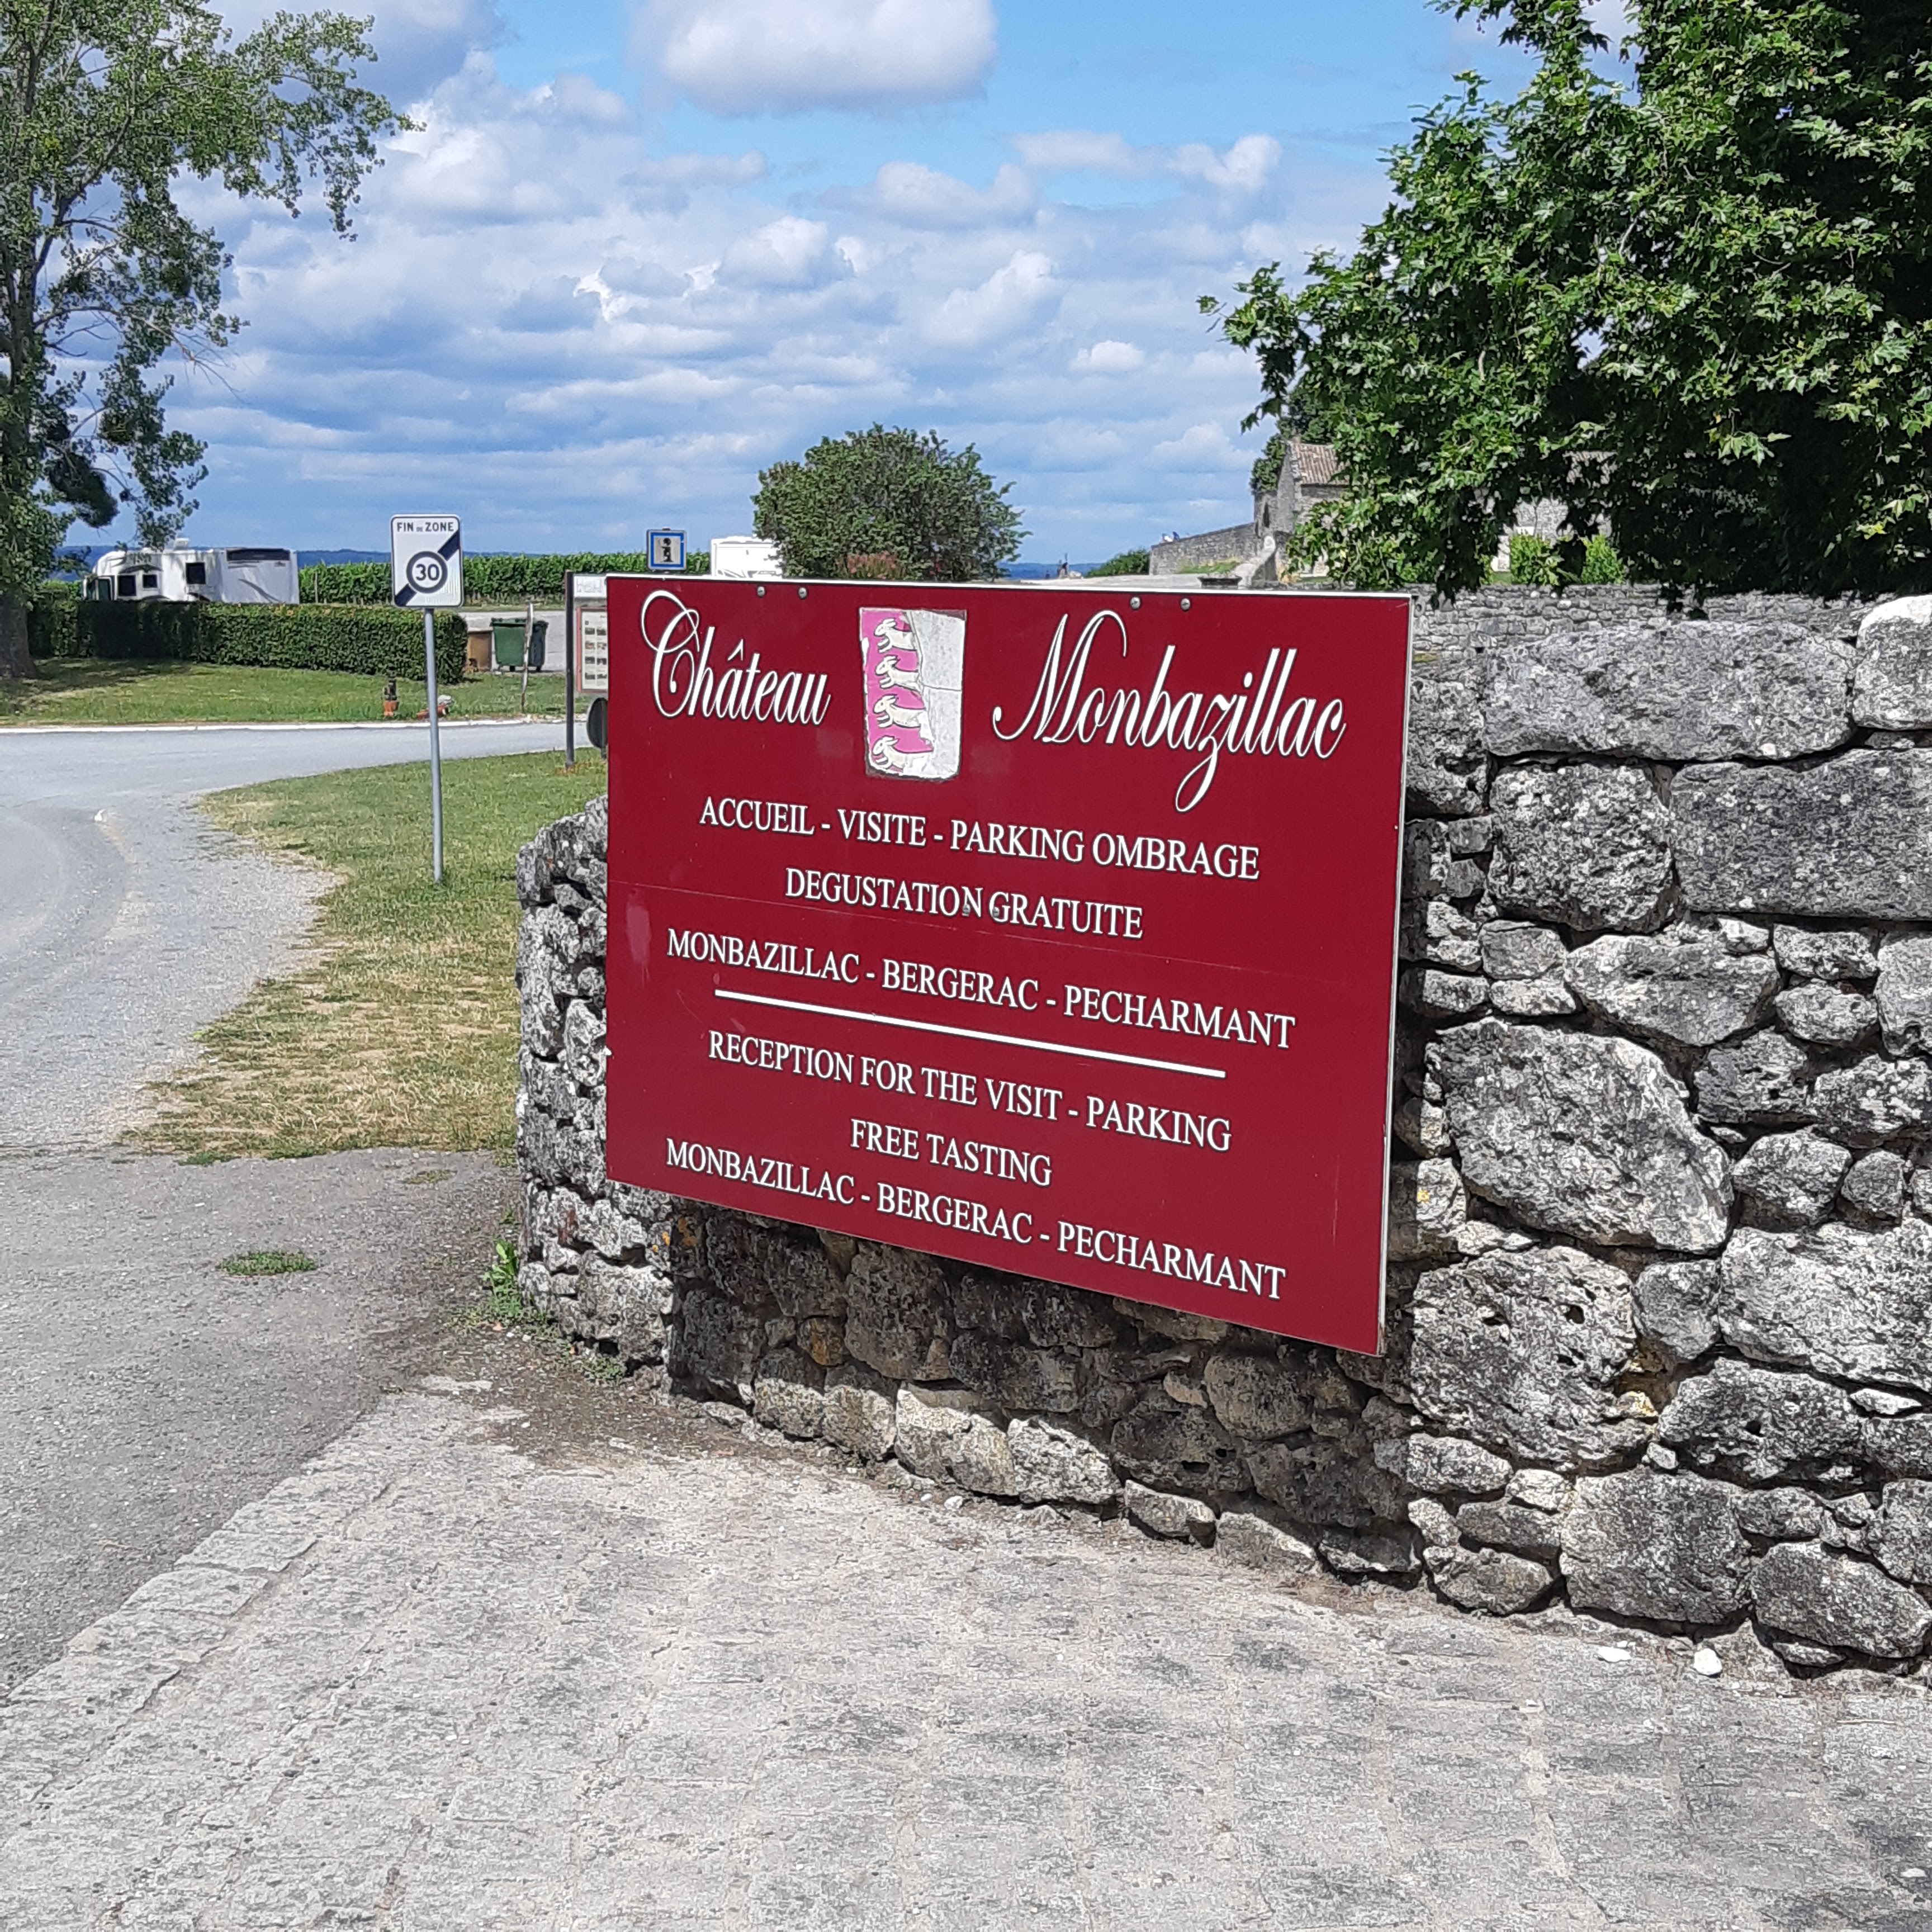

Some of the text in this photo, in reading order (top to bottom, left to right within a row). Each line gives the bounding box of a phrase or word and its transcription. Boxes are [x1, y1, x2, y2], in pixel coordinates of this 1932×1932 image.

[396, 522, 414, 532] FIN
[425, 522, 454, 532] ZONE
[415, 564, 440, 581] 30
[641, 590, 831, 725] Château
[992, 610, 1347, 812] Monbazillac
[699, 796, 815, 835] ACCUEIL
[837, 809, 927, 849] VISITE
[950, 820, 1085, 863] PARKING
[1092, 833, 1259, 879] OMBRAGE
[785, 868, 1143, 939] DEGUSTATION GRATUITE
[667, 928, 859, 984] MONBAZILLAC
[882, 959, 1038, 1011] BERGERAC
[1063, 984, 1295, 1048] PECHARMANT
[708, 1030, 854, 1083] RECEPTION
[860, 1056, 916, 1095] FOR
[921, 1067, 978, 1105] THE
[985, 1078, 1063, 1120] VISIT
[1086, 1096, 1232, 1152] PARKING
[850, 1119, 1052, 1186] FREE TASTING
[666, 1138, 854, 1205] MONBAZILLAC
[877, 1182, 1032, 1244] BERGERAC
[1057, 1220, 1286, 1300] PECHARMANT
